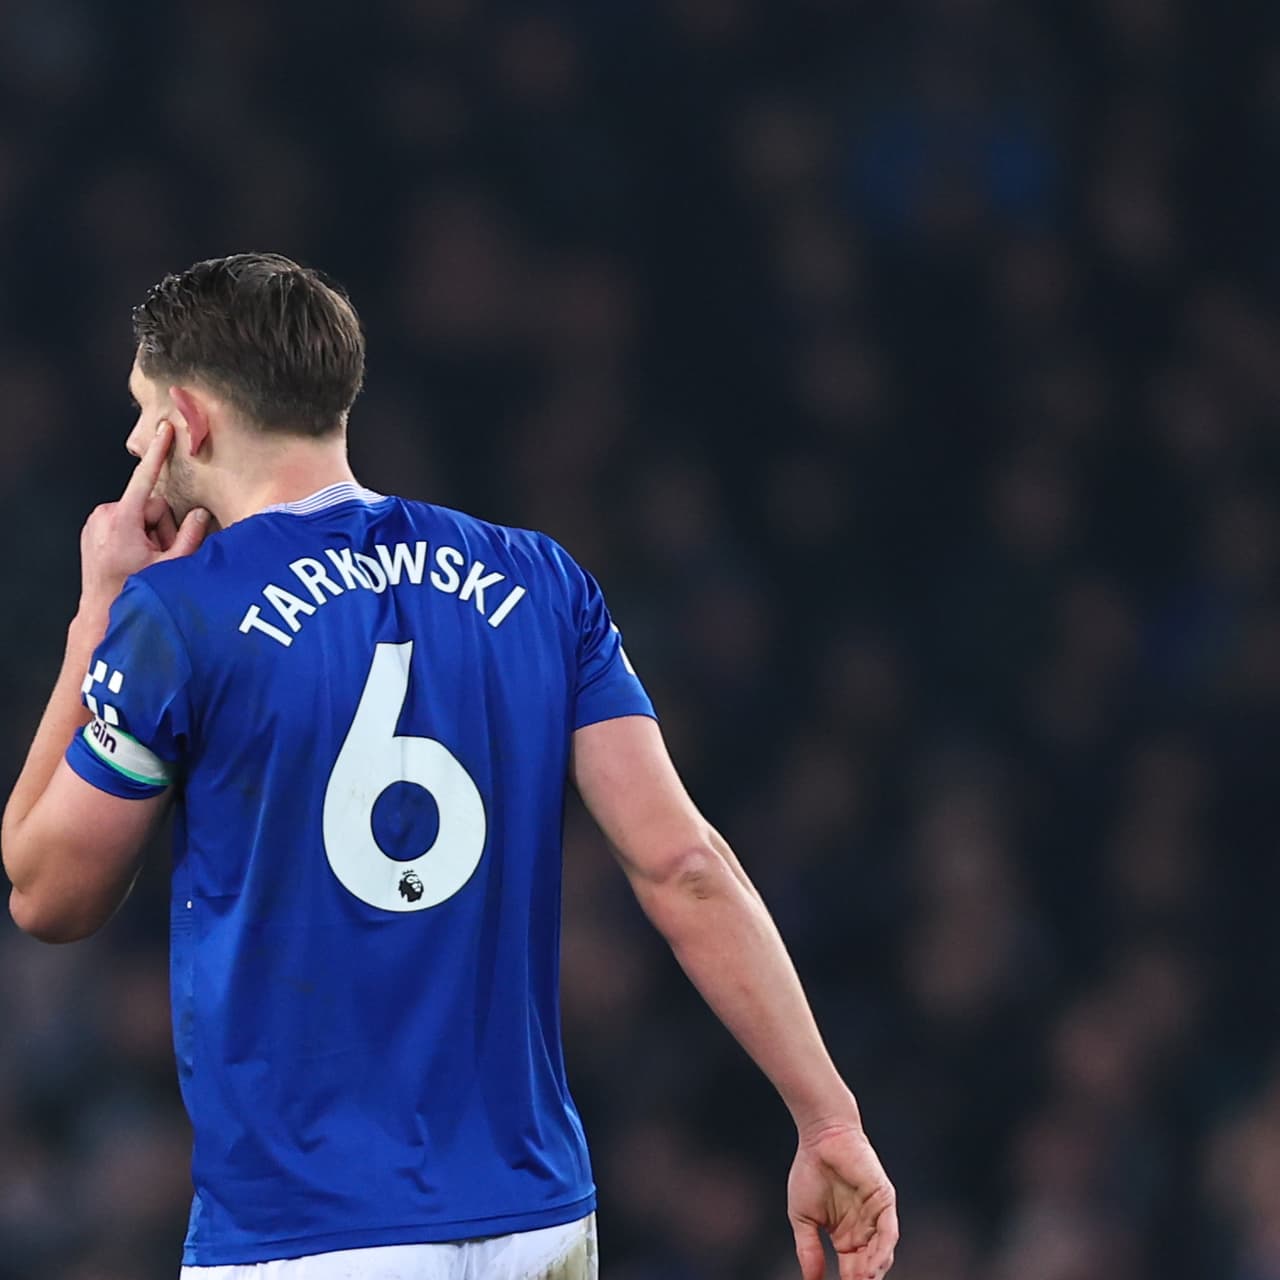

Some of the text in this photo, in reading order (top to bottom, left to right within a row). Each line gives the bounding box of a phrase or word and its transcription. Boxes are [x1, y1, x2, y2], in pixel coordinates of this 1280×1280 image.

[239, 540, 526, 648] TARKOWSKI
[90, 720, 118, 754] ain
[322, 639, 487, 913] 6
